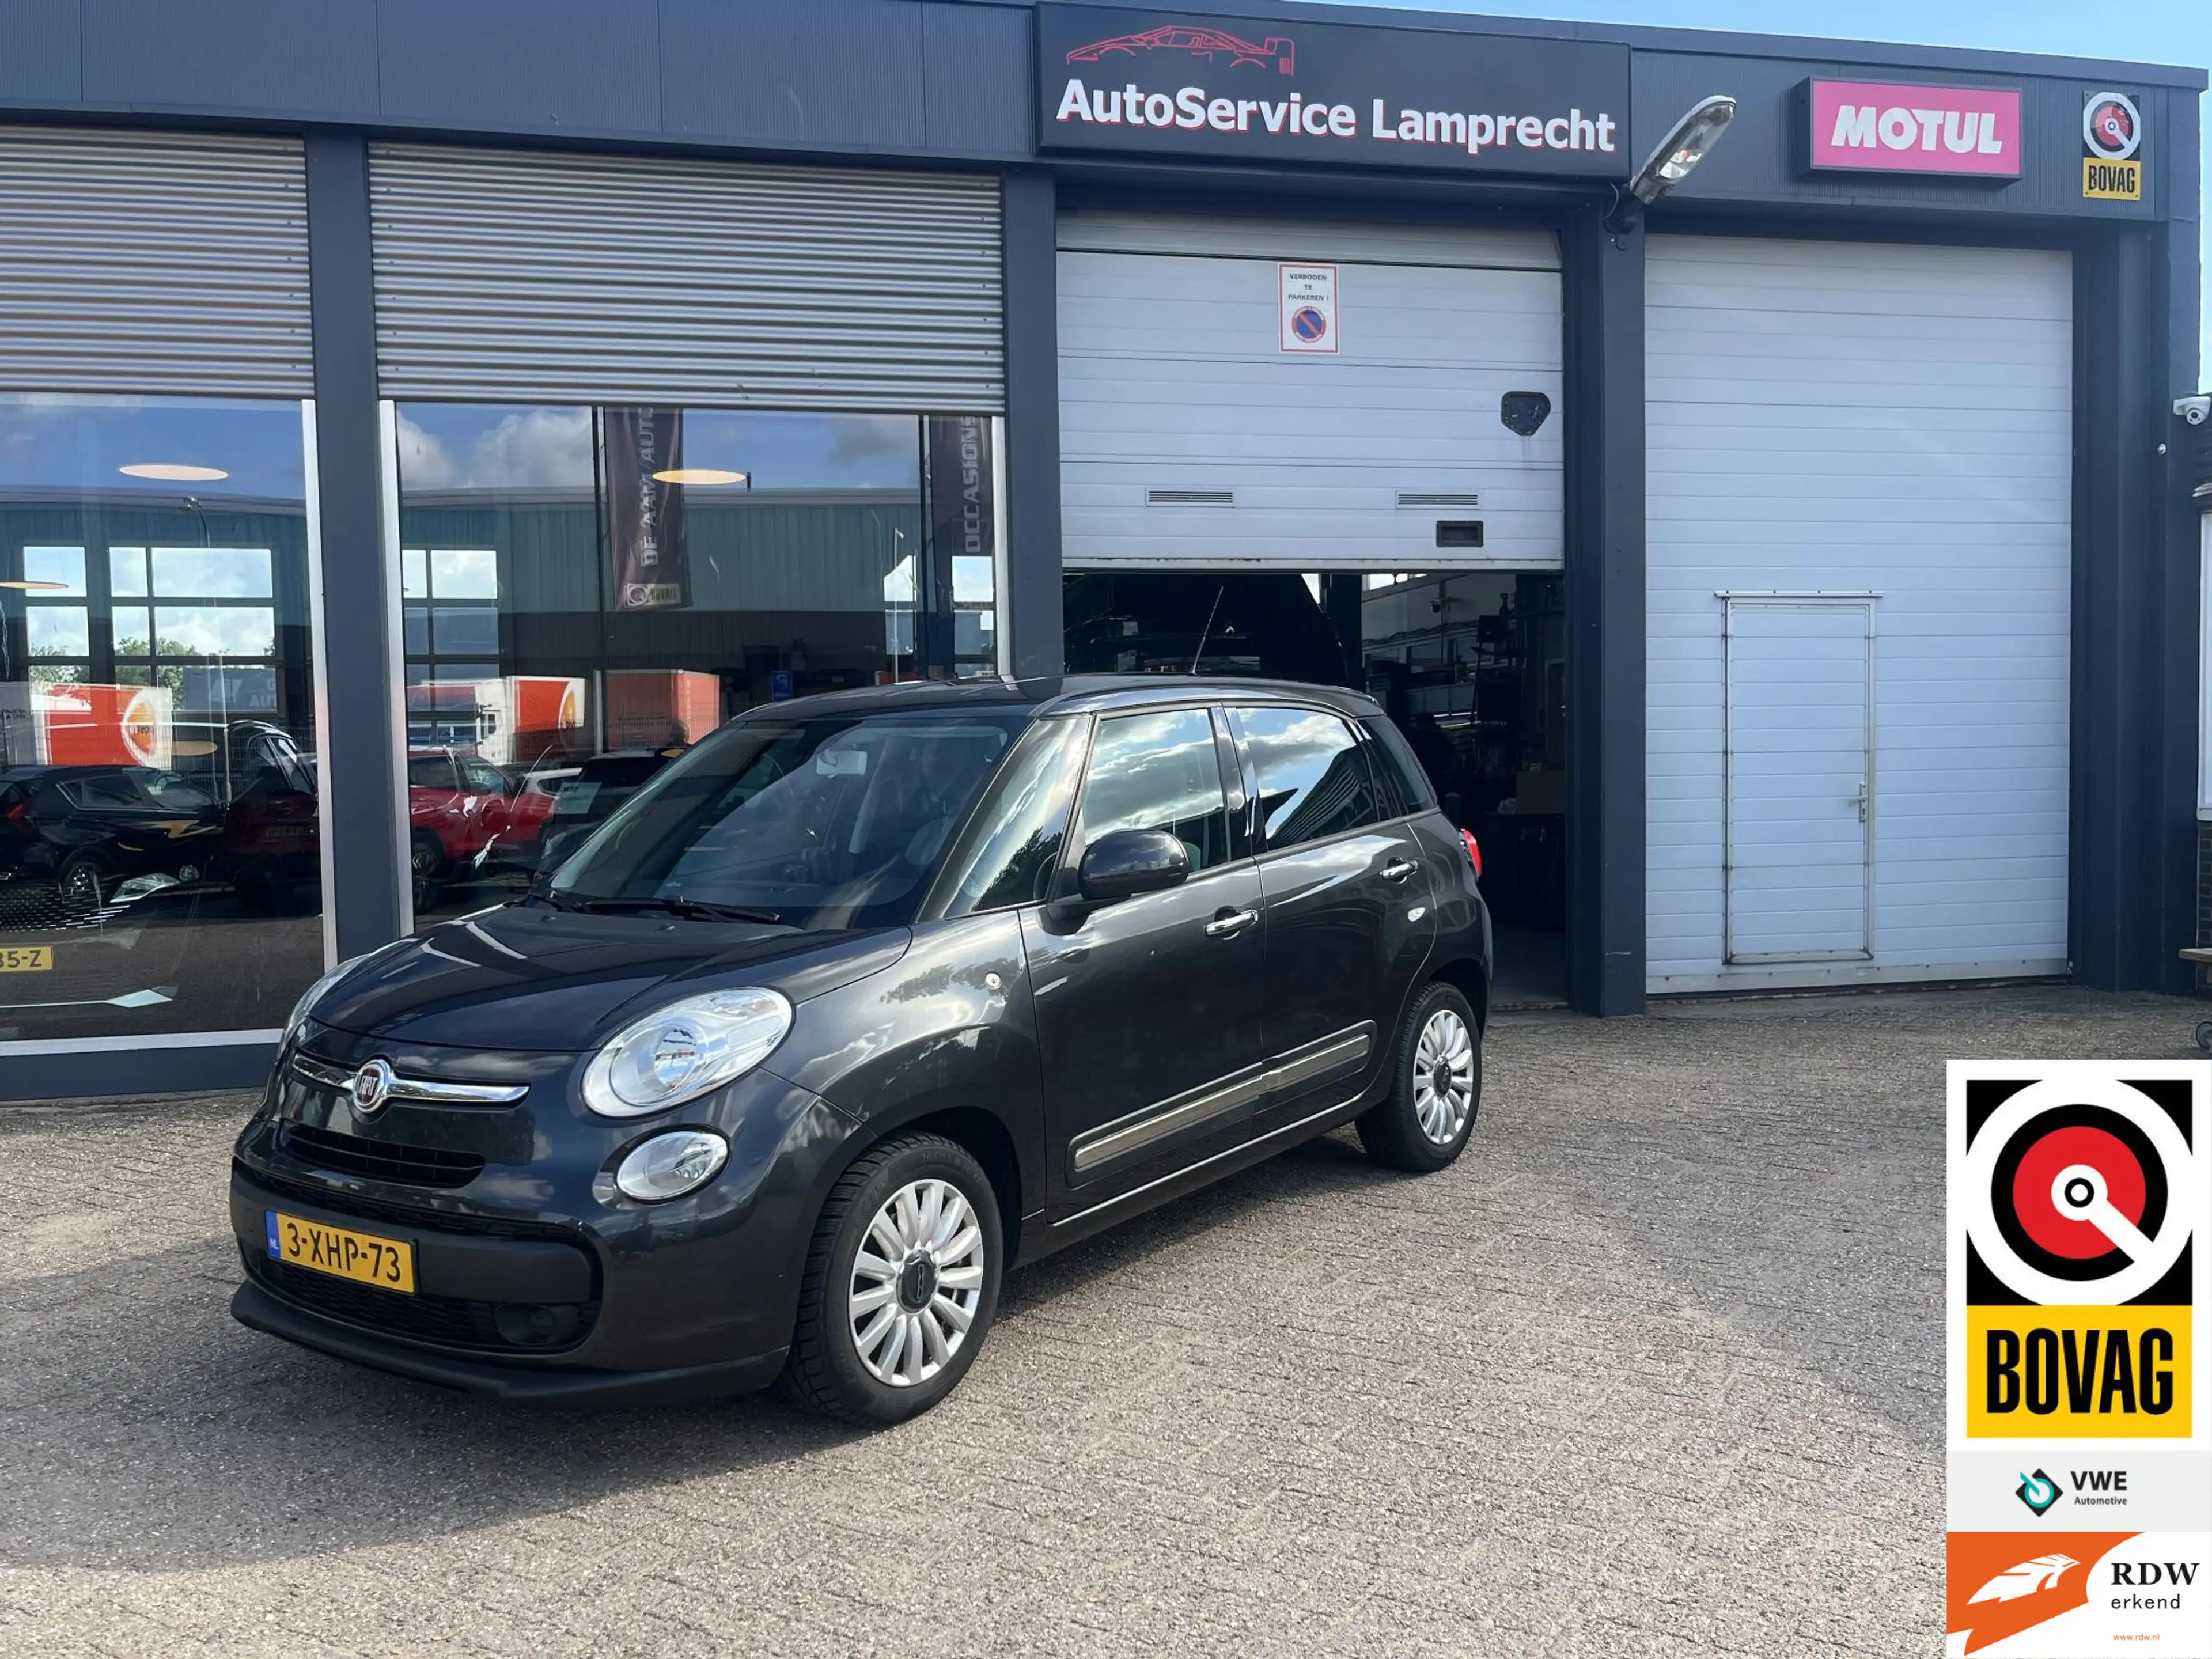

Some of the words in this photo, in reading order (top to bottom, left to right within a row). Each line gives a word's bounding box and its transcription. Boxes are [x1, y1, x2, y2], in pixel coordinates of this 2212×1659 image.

[1056, 78, 1356, 138] AutoService
[1372, 98, 1616, 155] Lamprecht
[1831, 105, 2003, 154] MOTUL
[2088, 164, 2137, 194] BOVAG
[1289, 273, 1327, 281] VERBODEN
[287, 1222, 401, 1282] 3-XHP-73
